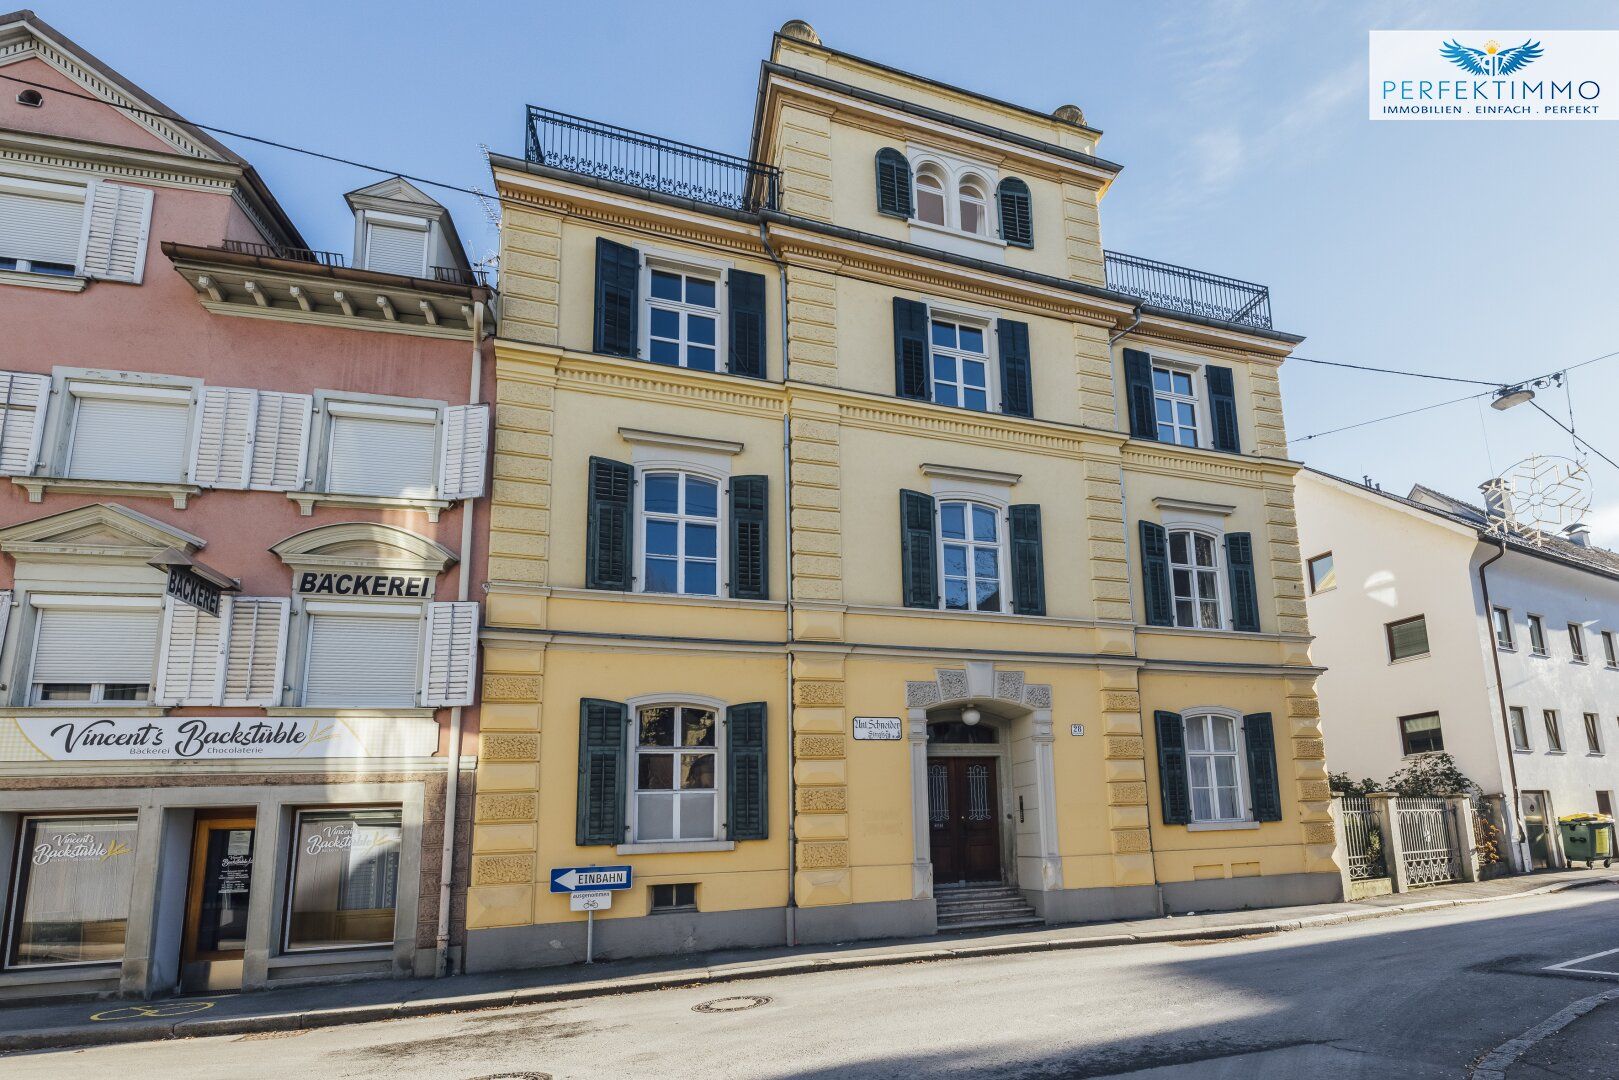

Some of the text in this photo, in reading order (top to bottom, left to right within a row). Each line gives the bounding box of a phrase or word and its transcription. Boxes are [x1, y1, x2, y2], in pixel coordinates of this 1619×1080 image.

[299, 572, 430, 597] BÄCKEREI
[50, 719, 307, 757] Vincent's Backstüble
[207, 746, 264, 755] Chocolaterie
[323, 825, 359, 838] Vincen
[578, 872, 623, 884] EINBAHN
